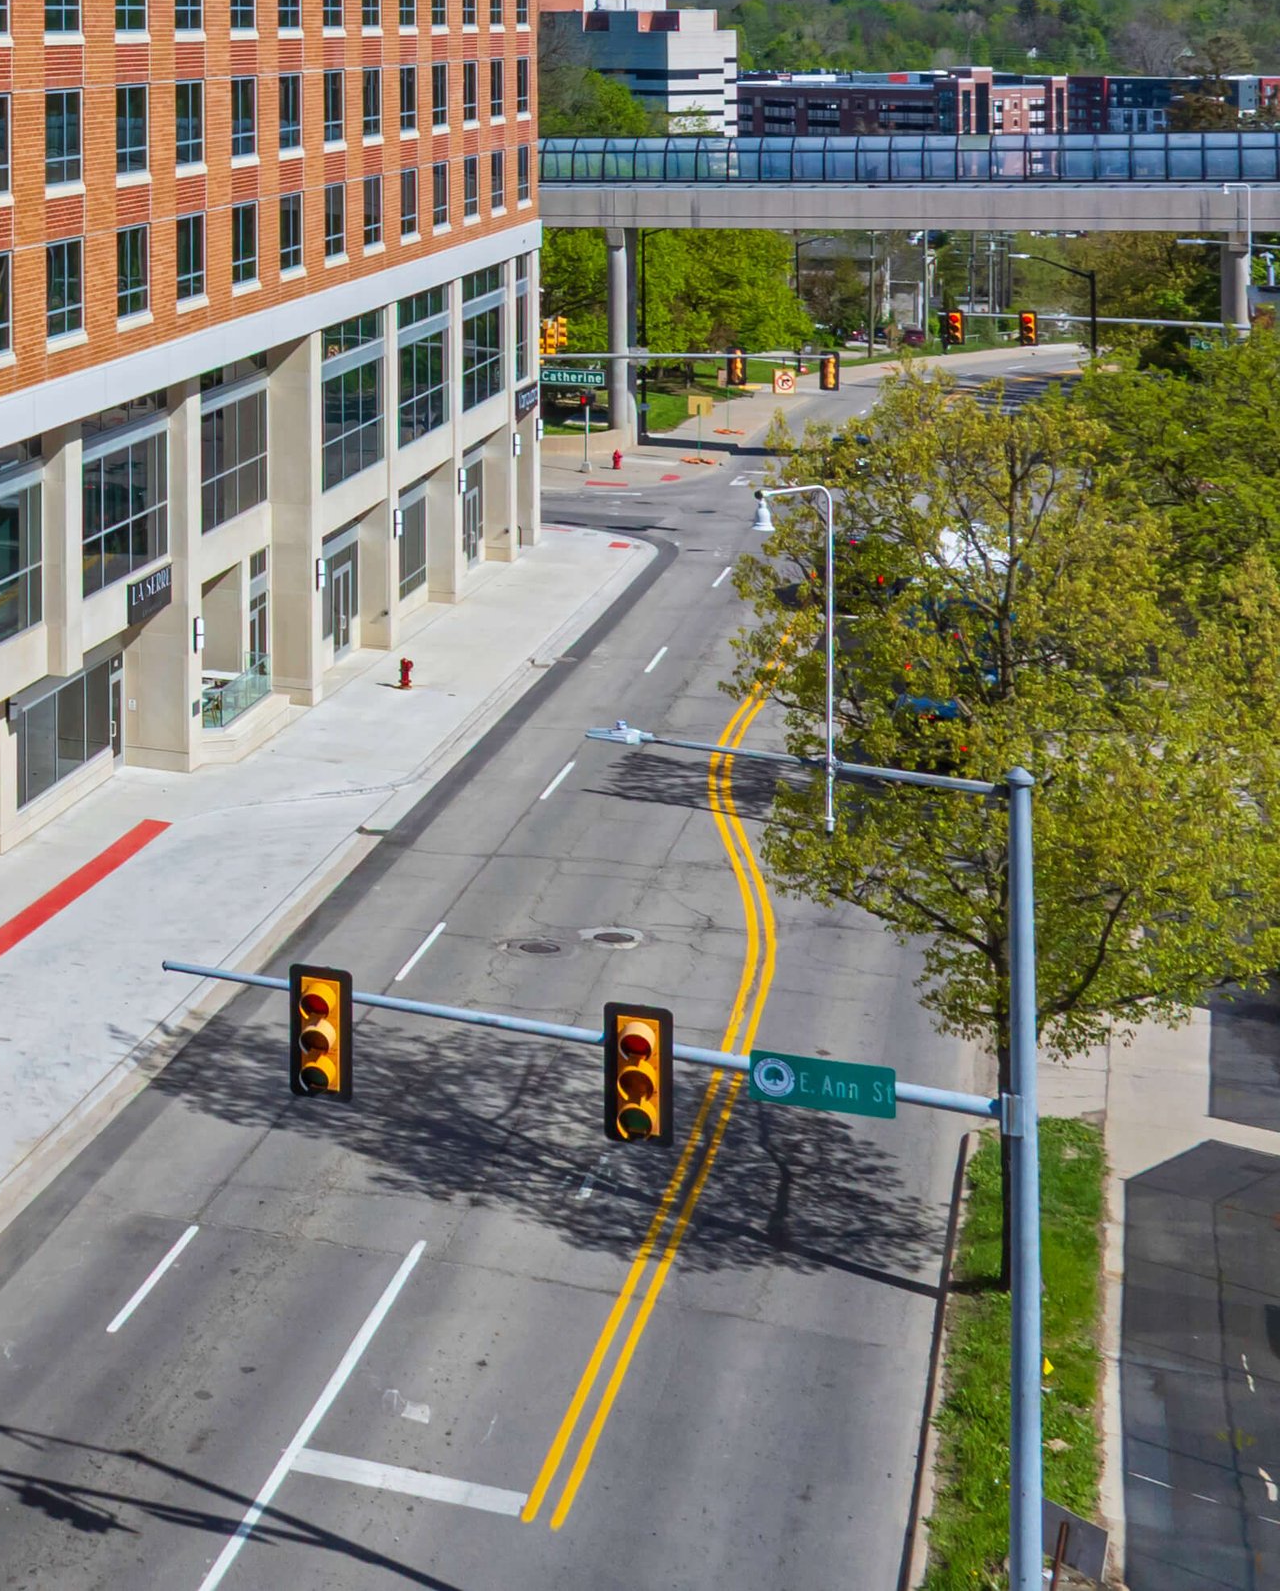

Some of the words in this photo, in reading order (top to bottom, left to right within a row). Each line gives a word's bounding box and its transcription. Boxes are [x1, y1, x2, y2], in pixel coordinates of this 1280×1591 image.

[541, 371, 602, 384] Catherine
[132, 582, 144, 606] LA
[799, 1072, 815, 1094] E.
[821, 1075, 858, 1100] Ann
[872, 1081, 894, 1105] St
